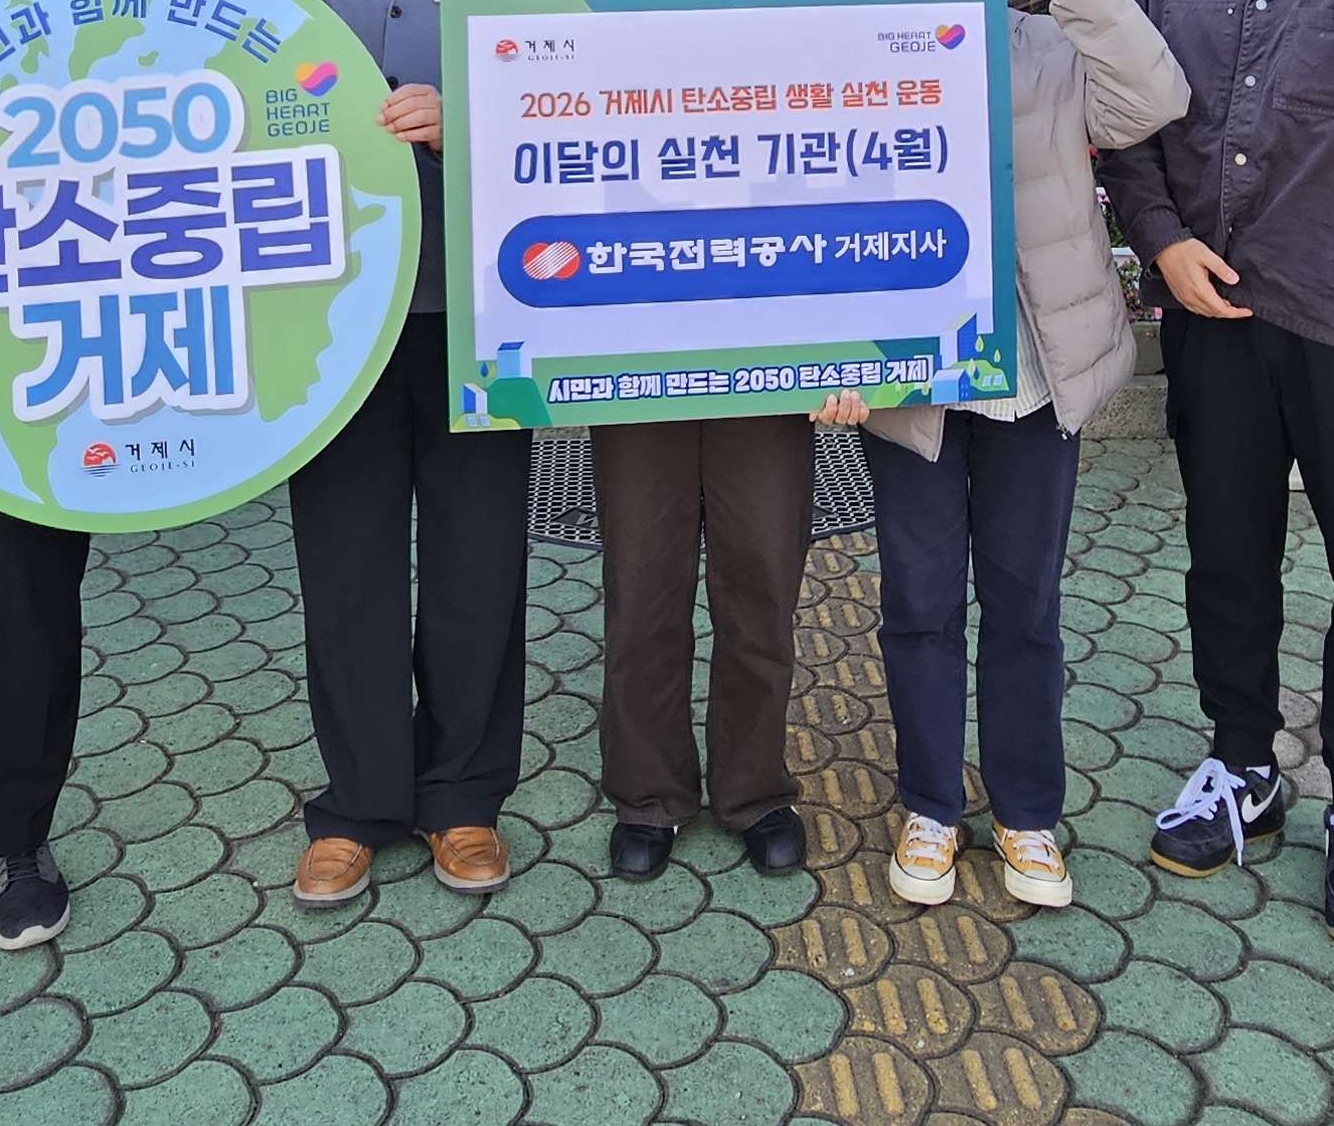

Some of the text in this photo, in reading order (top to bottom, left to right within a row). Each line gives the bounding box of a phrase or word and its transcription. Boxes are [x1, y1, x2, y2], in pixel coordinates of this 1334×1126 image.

[525, 39, 575, 53] 거제시
[877, 31, 931, 41] BIG HEART
[890, 40, 936, 53] GEOJE
[265, 88, 299, 104] BIG
[520, 78, 942, 118] 2026 거제시 탄소중립 생활 실천 운동
[266, 102, 331, 120] HEART
[3, 82, 232, 169] 2050
[267, 119, 331, 138] GEOJE
[514, 125, 950, 185] 이달의 실천 기관(4월)
[585, 228, 947, 274] 한국전력공사 거제지사
[22, 286, 236, 408] 거제
[548, 357, 929, 403] 시민과 함께 만드는 2050 탄소중립 거제
[125, 438, 195, 461] 거제시
[130, 460, 195, 473] GEOJE-SI
